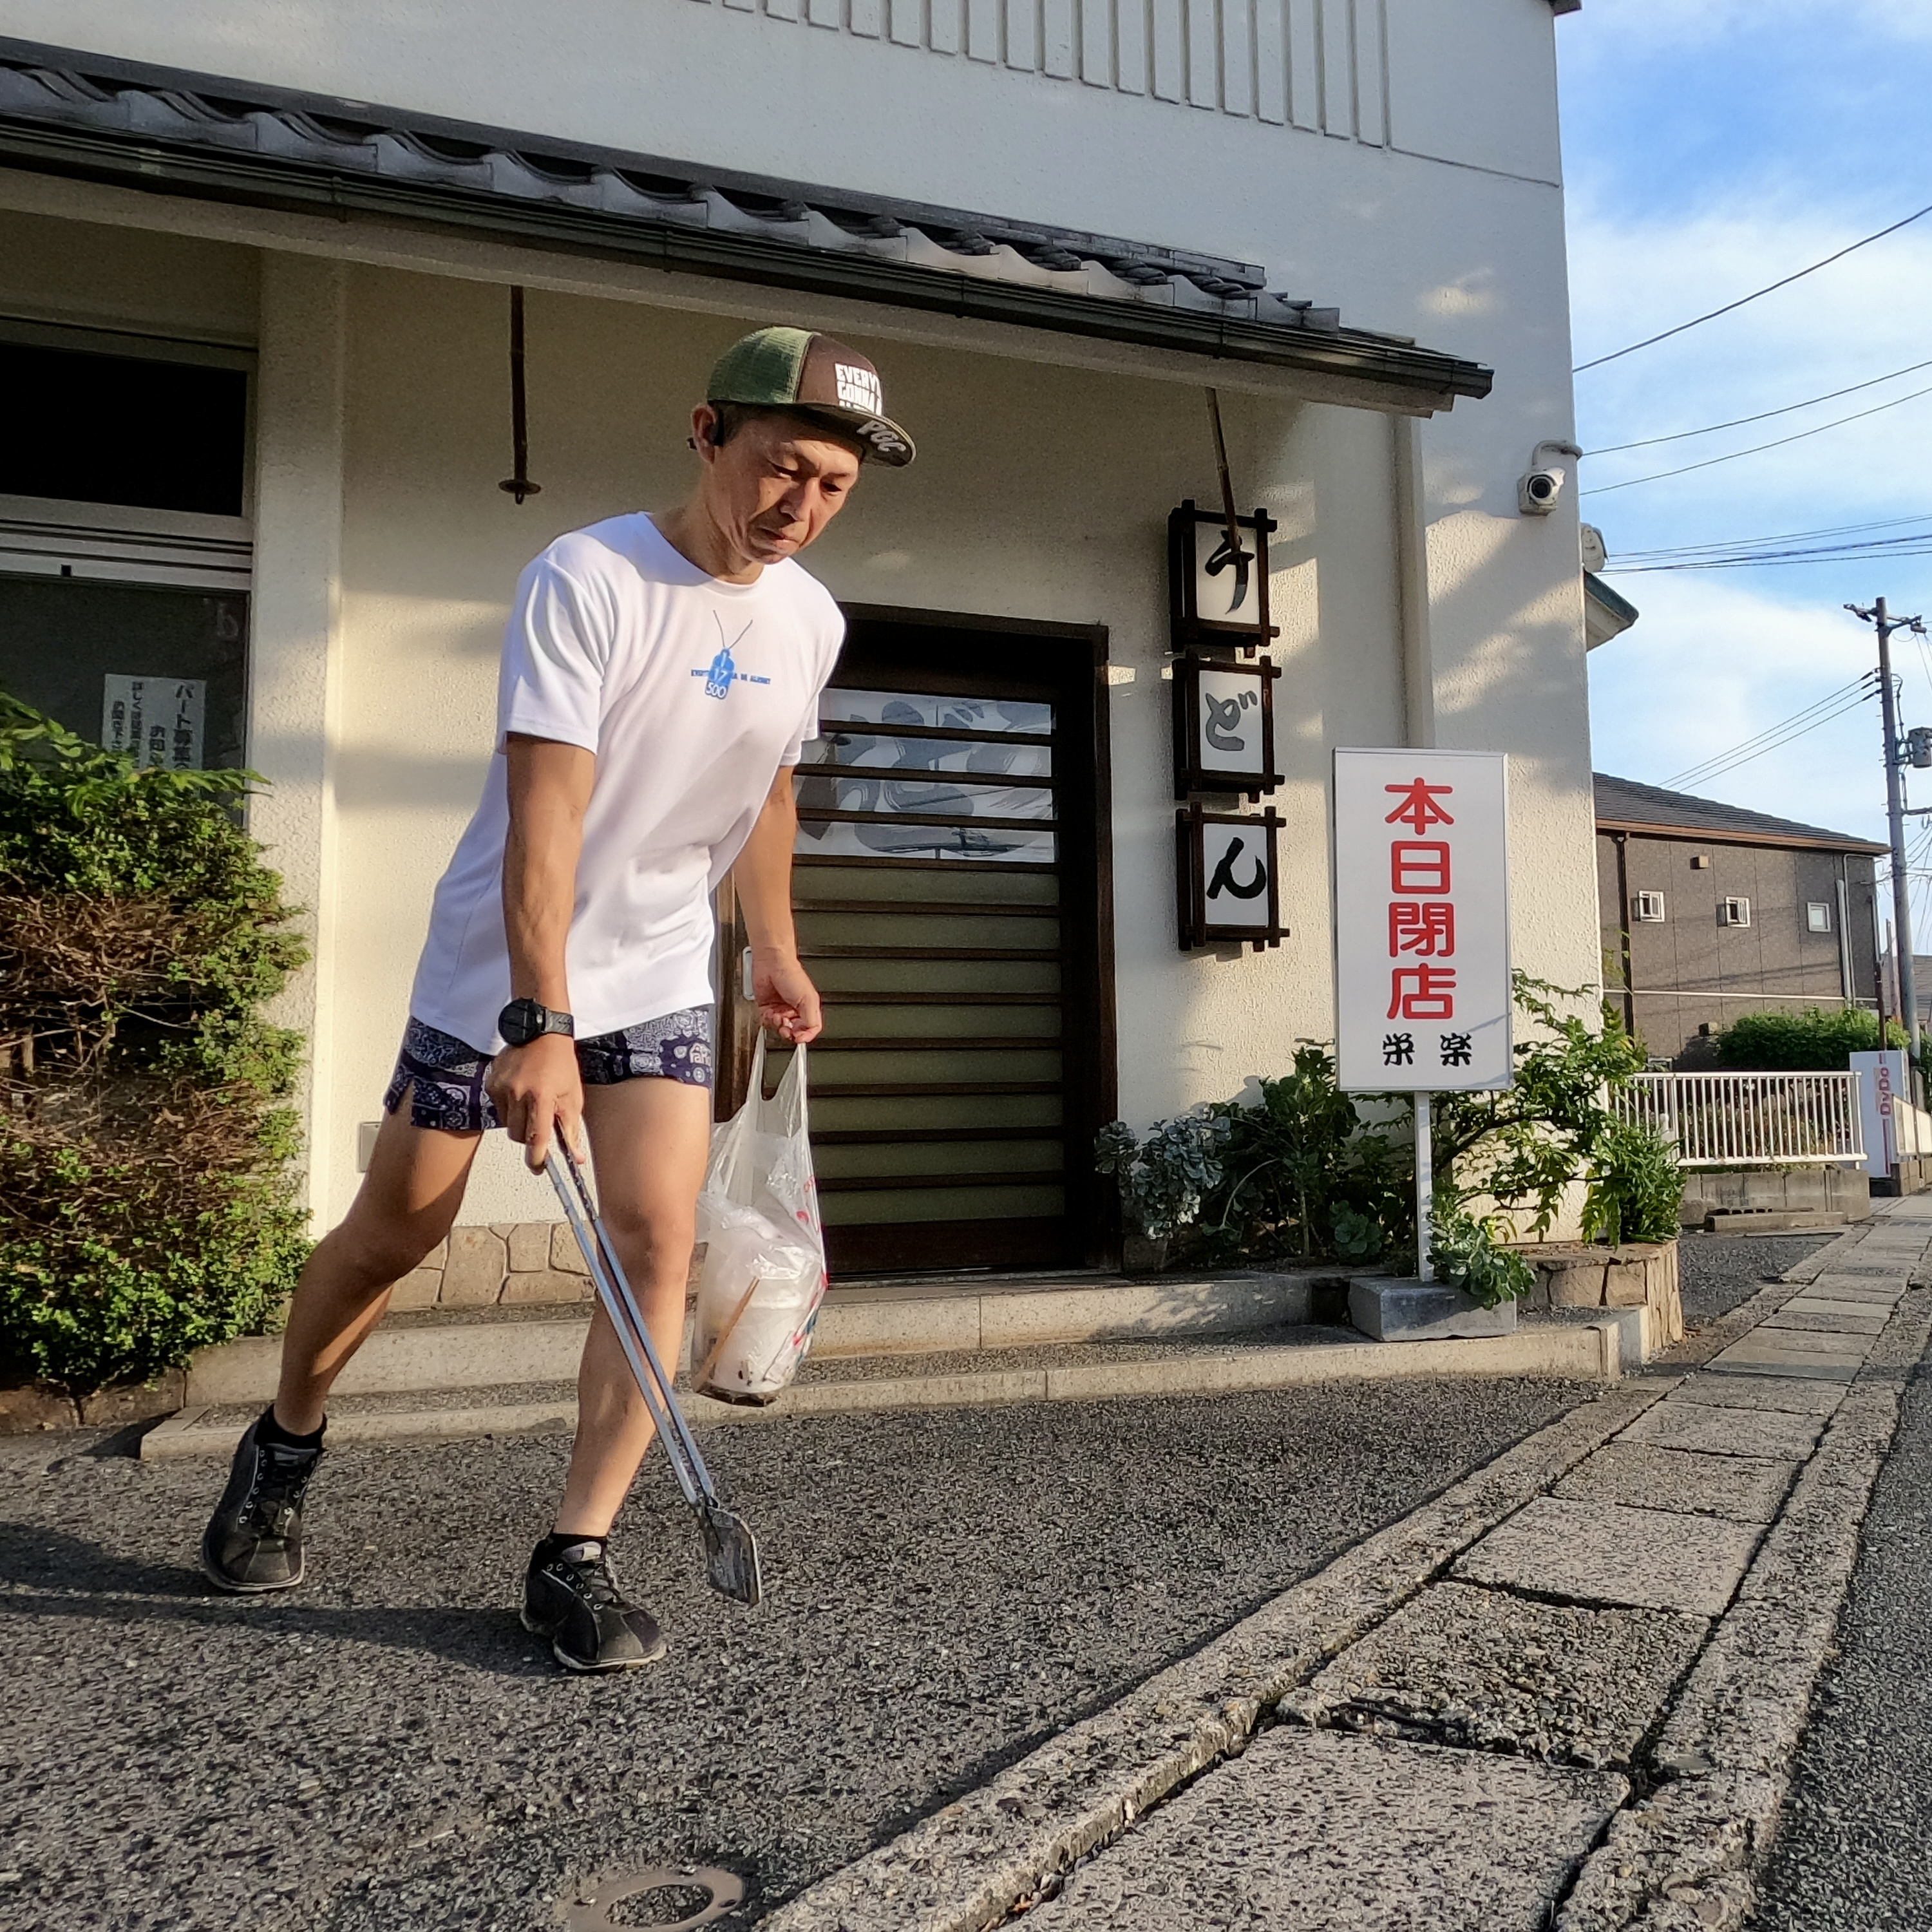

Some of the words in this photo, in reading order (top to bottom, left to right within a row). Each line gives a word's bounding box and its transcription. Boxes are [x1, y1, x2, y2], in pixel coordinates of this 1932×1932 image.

[705, 681, 727, 698] 500
[1384, 777, 1457, 1020] 本日閉店
